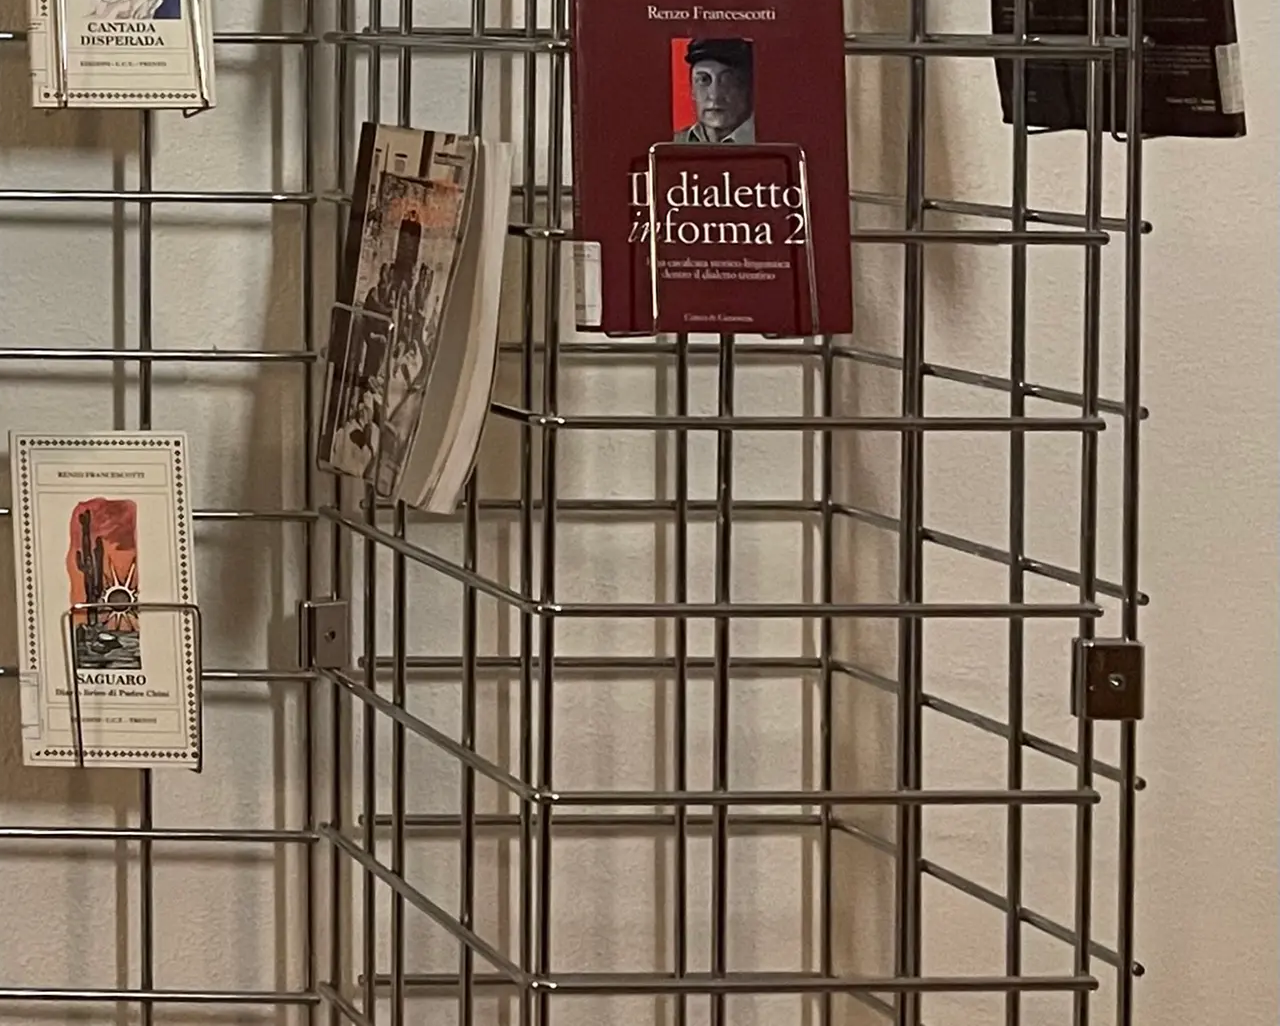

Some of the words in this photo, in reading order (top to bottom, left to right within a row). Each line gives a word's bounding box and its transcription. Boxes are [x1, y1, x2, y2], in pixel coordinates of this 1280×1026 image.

[647, 5, 690, 20] Renzo
[693, 5, 776, 21] Francescotti
[87, 22, 156, 33] CANTADA
[80, 35, 164, 46] DISPERADA
[666, 170, 804, 209] dialetto
[784, 213, 806, 244] 2
[76, 673, 146, 686] SAGUARO
